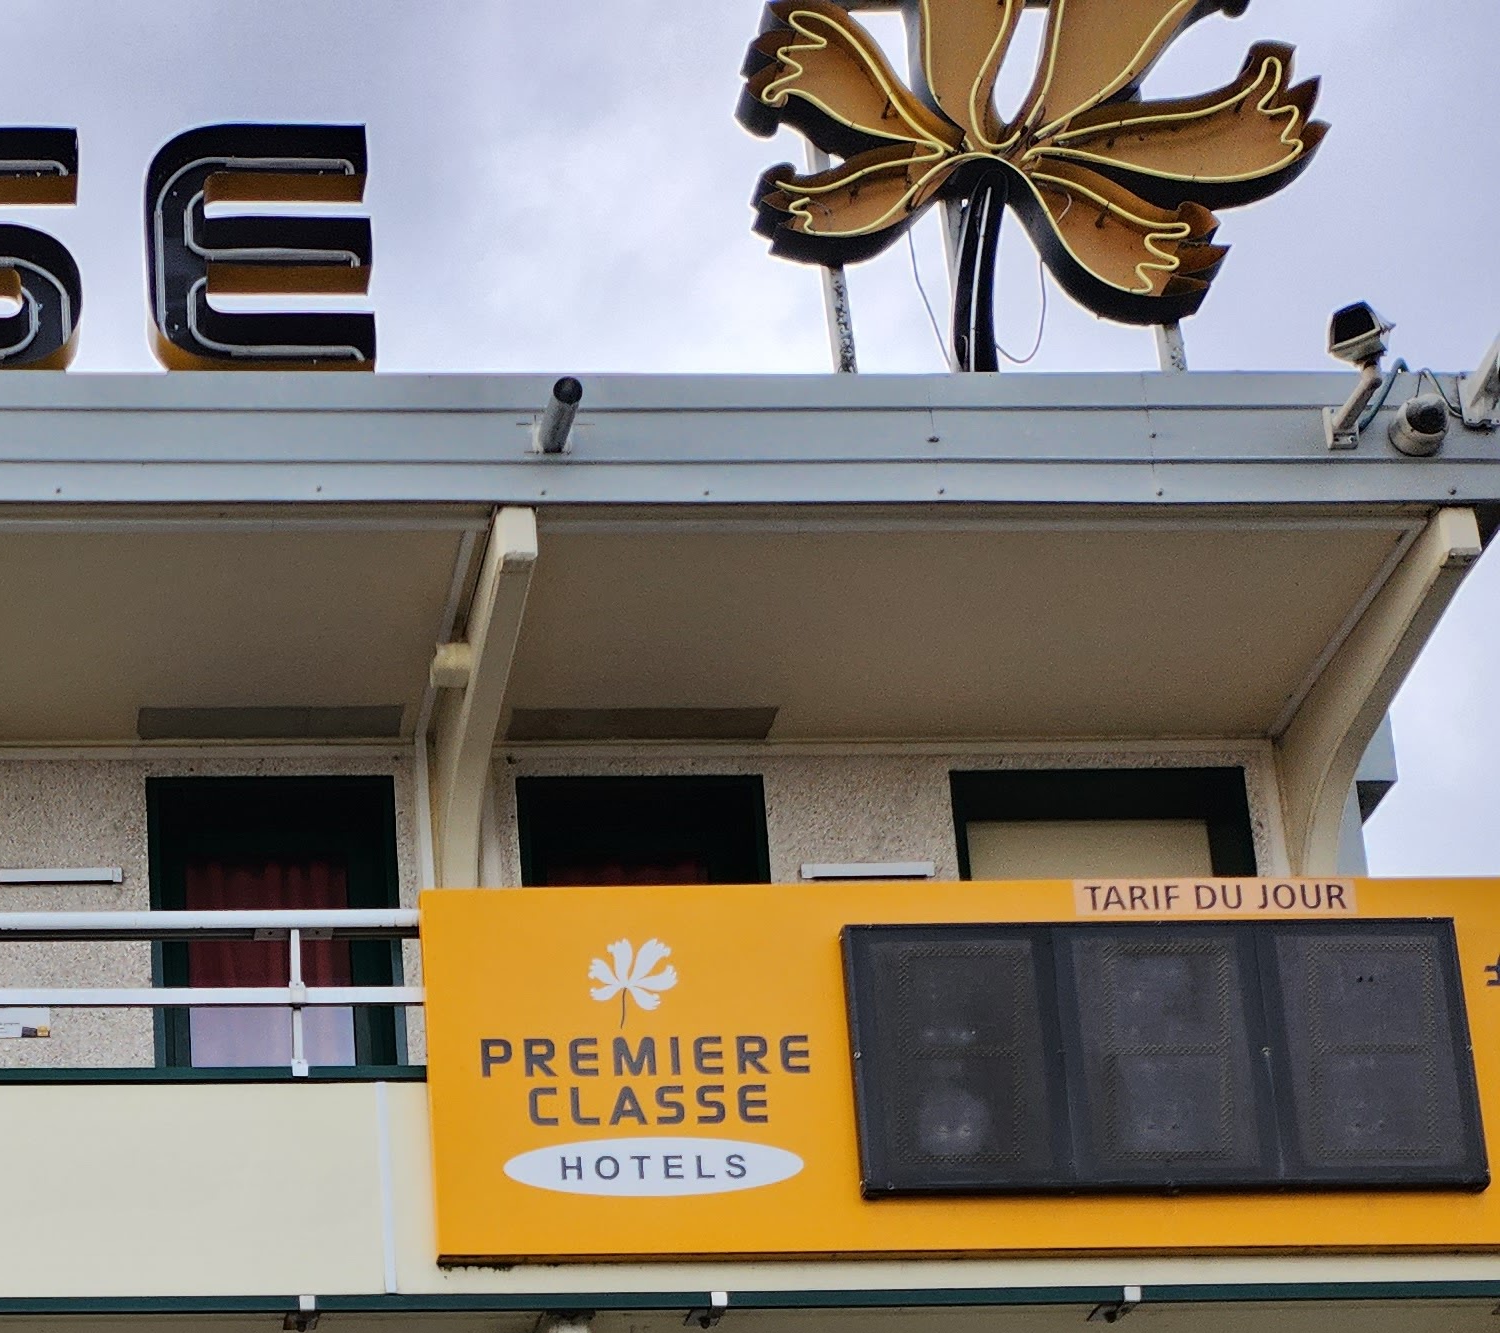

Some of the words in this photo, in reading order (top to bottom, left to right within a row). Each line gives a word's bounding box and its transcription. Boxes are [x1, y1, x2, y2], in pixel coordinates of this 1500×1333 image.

[1083, 884, 1181, 911] TARIF
[1194, 884, 1243, 910] DU
[1257, 883, 1347, 910] JOUR
[479, 1034, 811, 1078] PREMIERE
[527, 1083, 769, 1126] CLASSE
[559, 1153, 748, 1181] HOTELS
